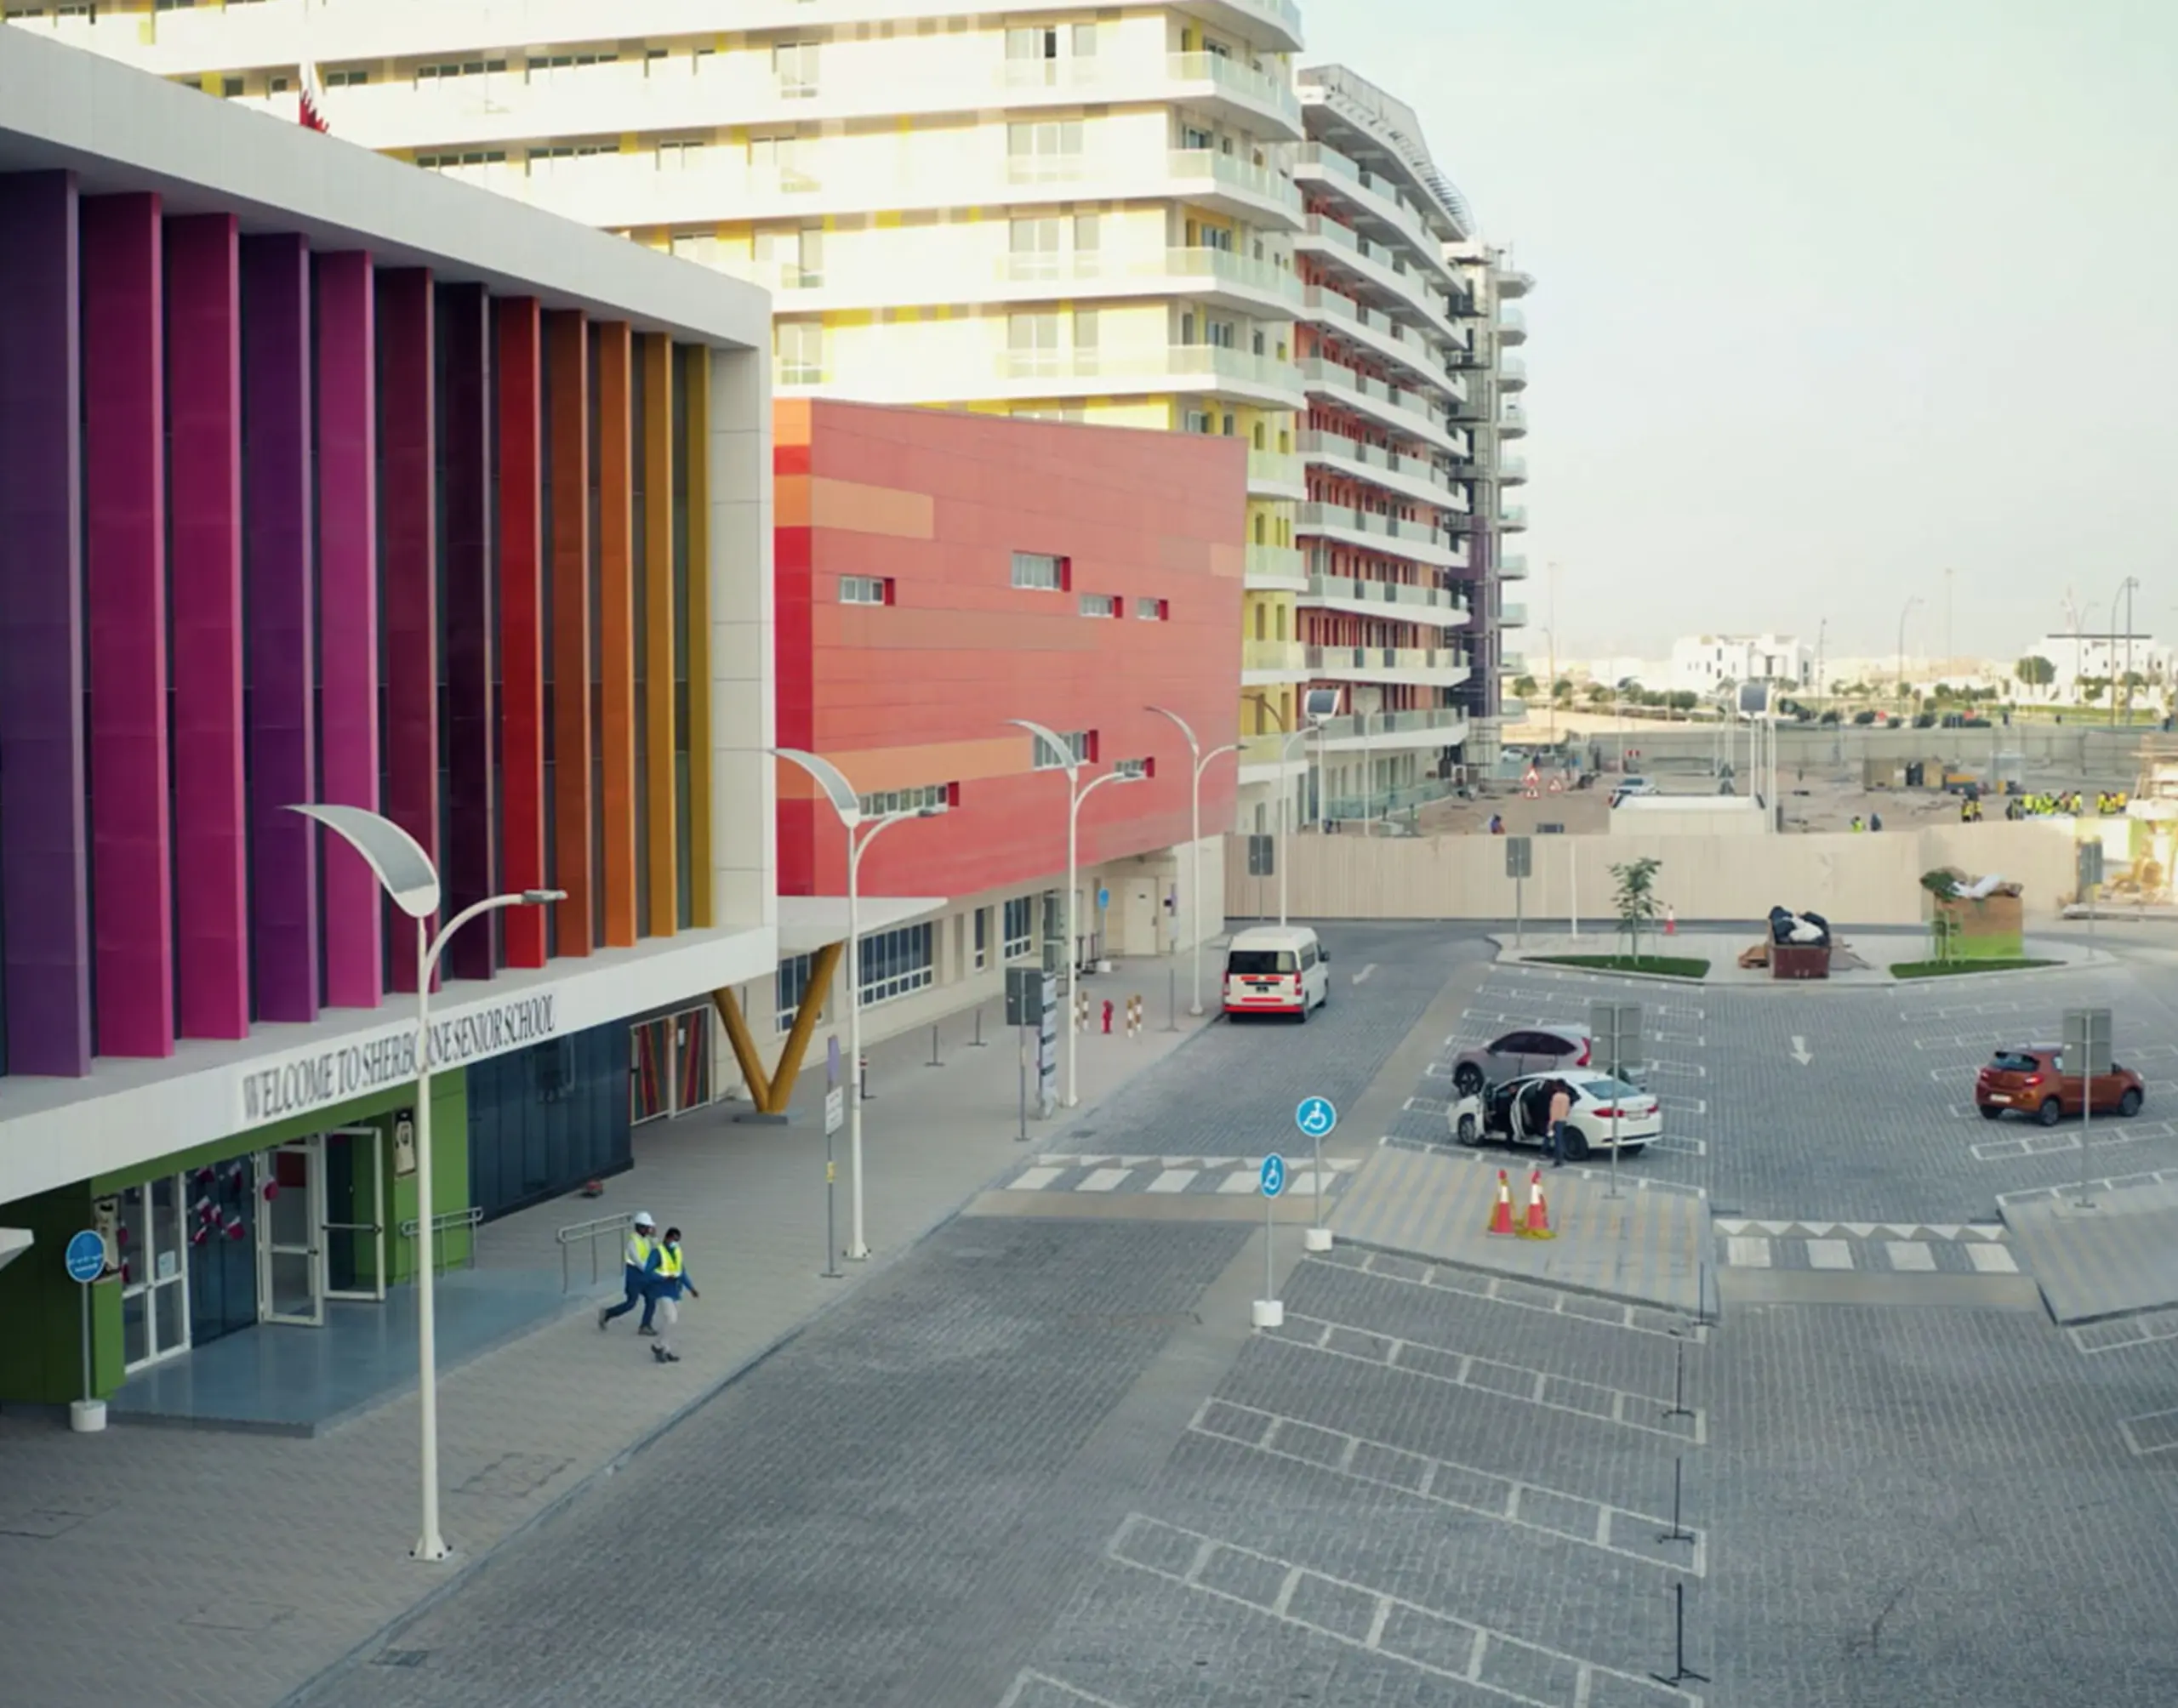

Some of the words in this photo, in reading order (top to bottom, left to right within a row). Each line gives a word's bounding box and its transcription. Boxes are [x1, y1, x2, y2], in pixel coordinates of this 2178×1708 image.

[242, 1052, 334, 1120] WELCOME
[337, 1045, 360, 1096] TO
[453, 1009, 503, 1060] SENIOR
[505, 994, 556, 1044] SCHOOL
